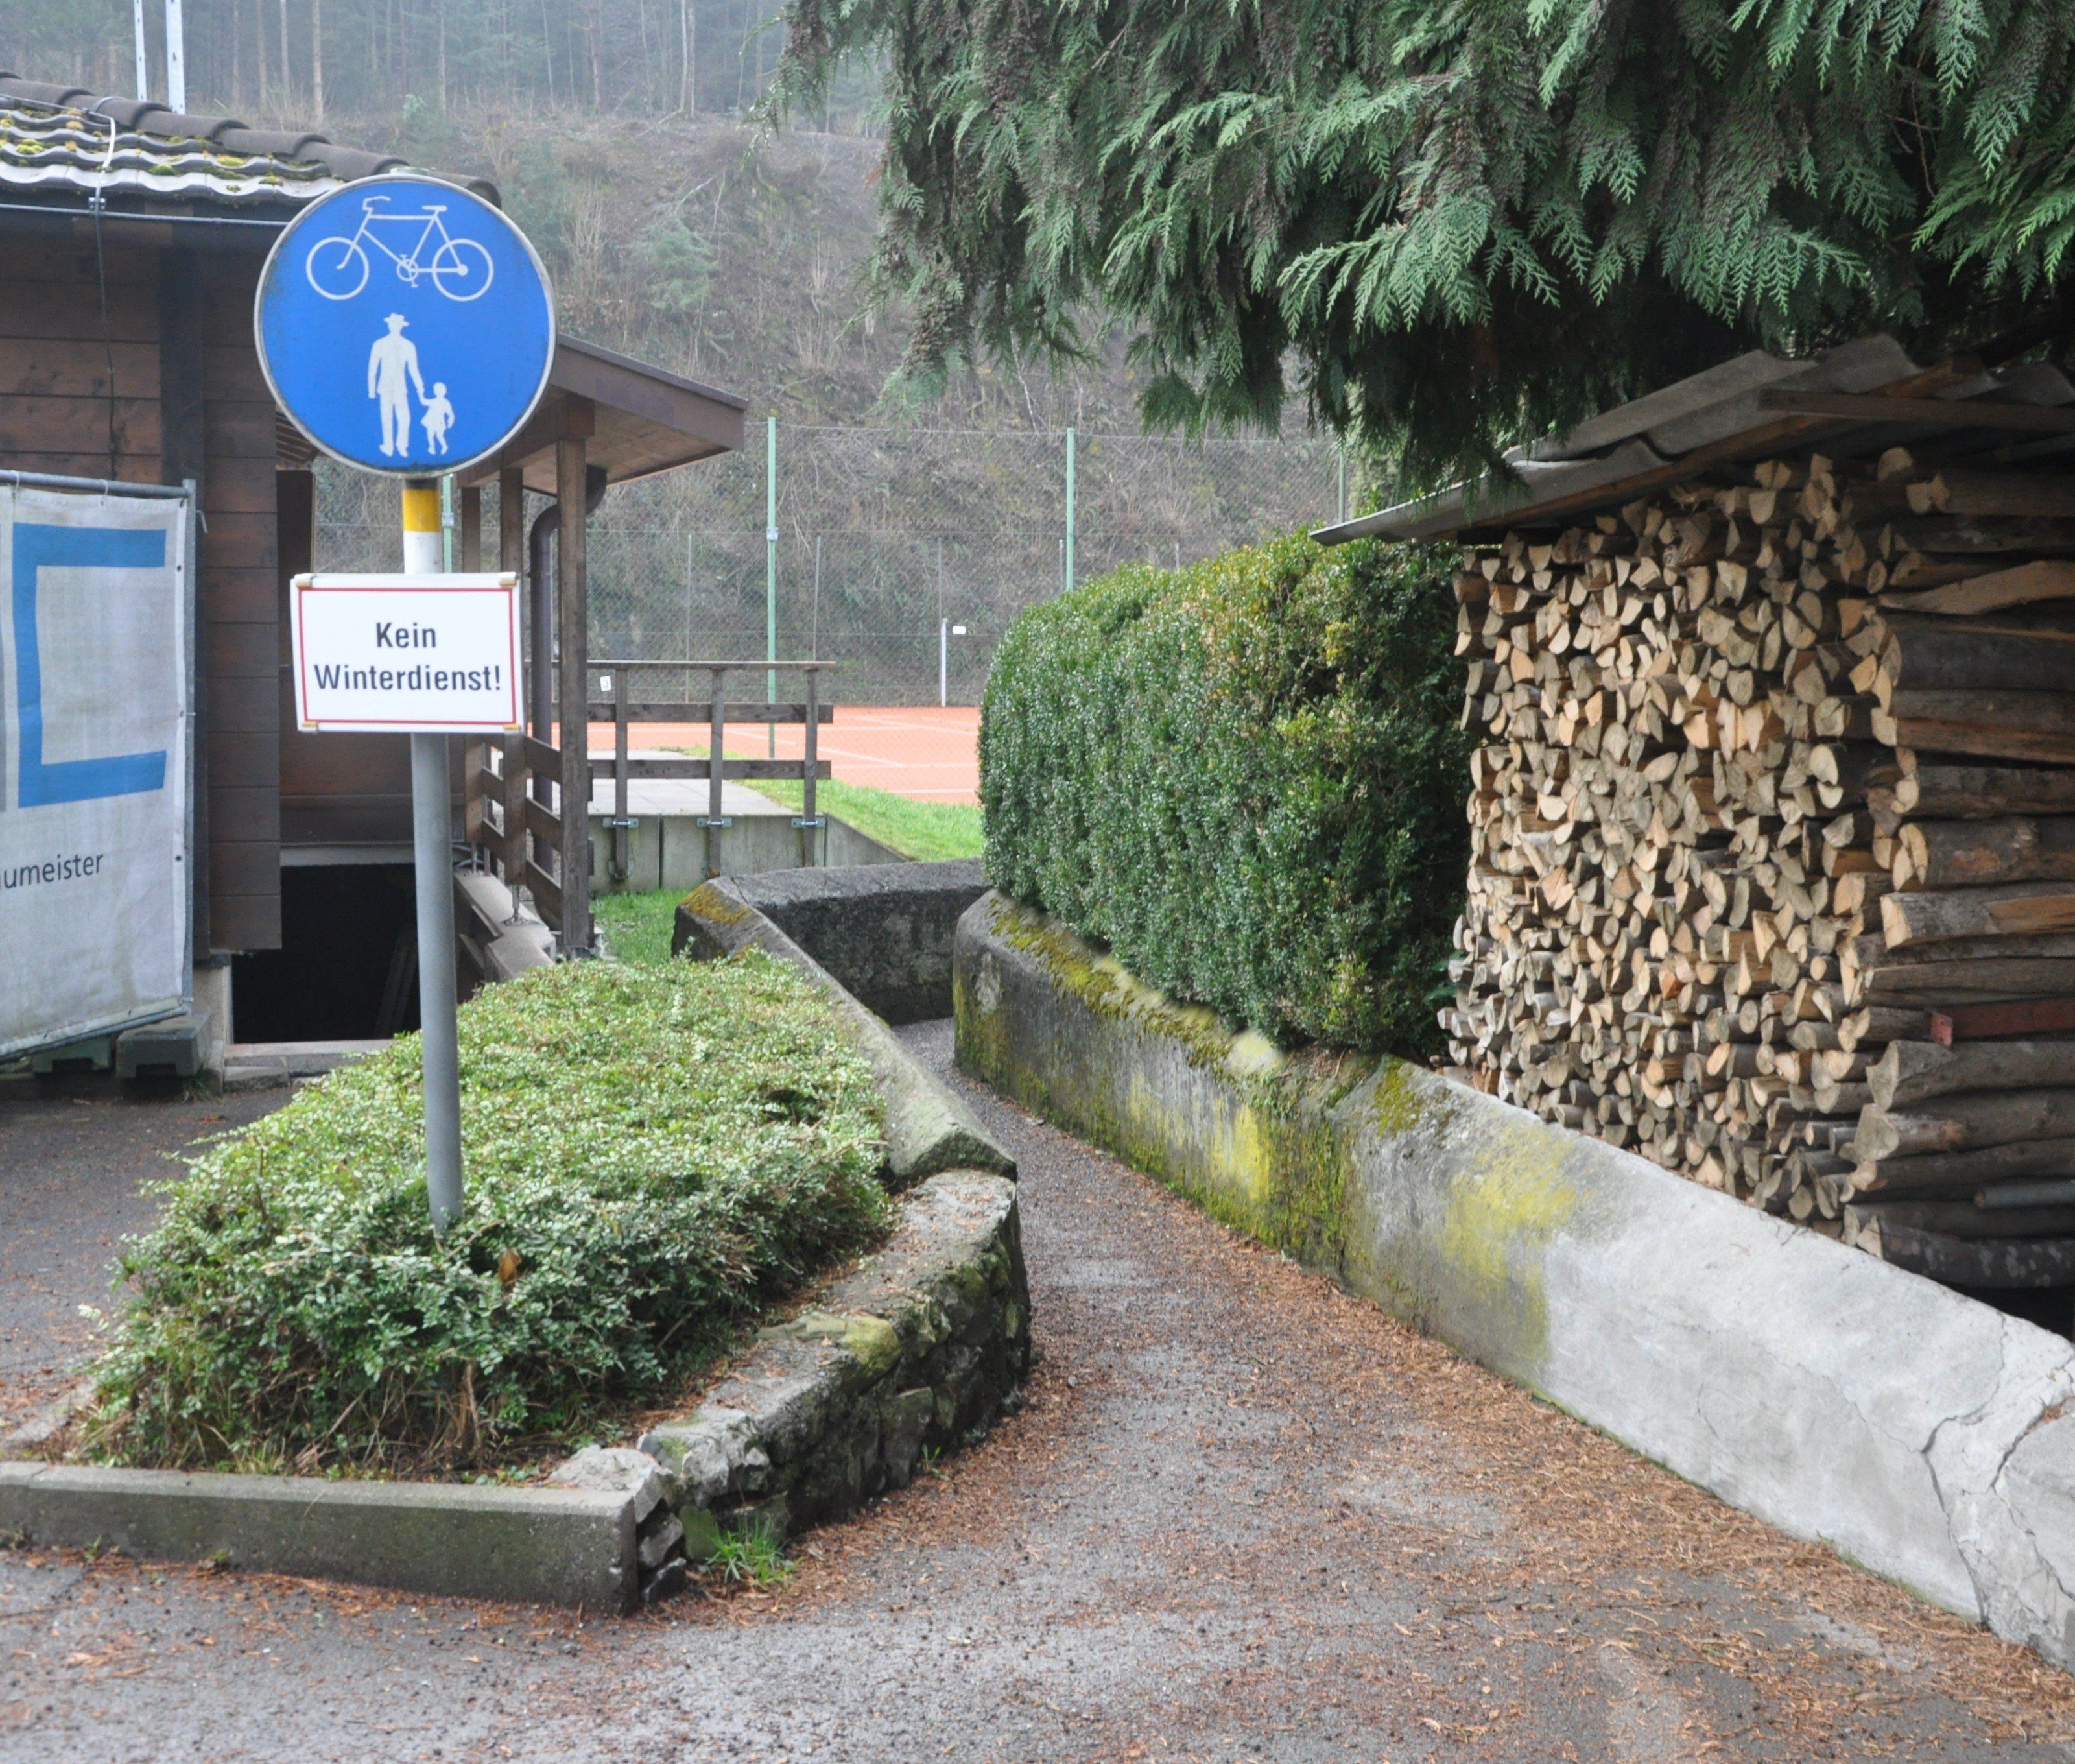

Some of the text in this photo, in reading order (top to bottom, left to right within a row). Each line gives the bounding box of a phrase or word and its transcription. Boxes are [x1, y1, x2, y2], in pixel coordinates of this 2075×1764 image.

[376, 622, 436, 648] Kein
[314, 664, 501, 691] Winterdienst!
[0, 853, 104, 888] umeister
